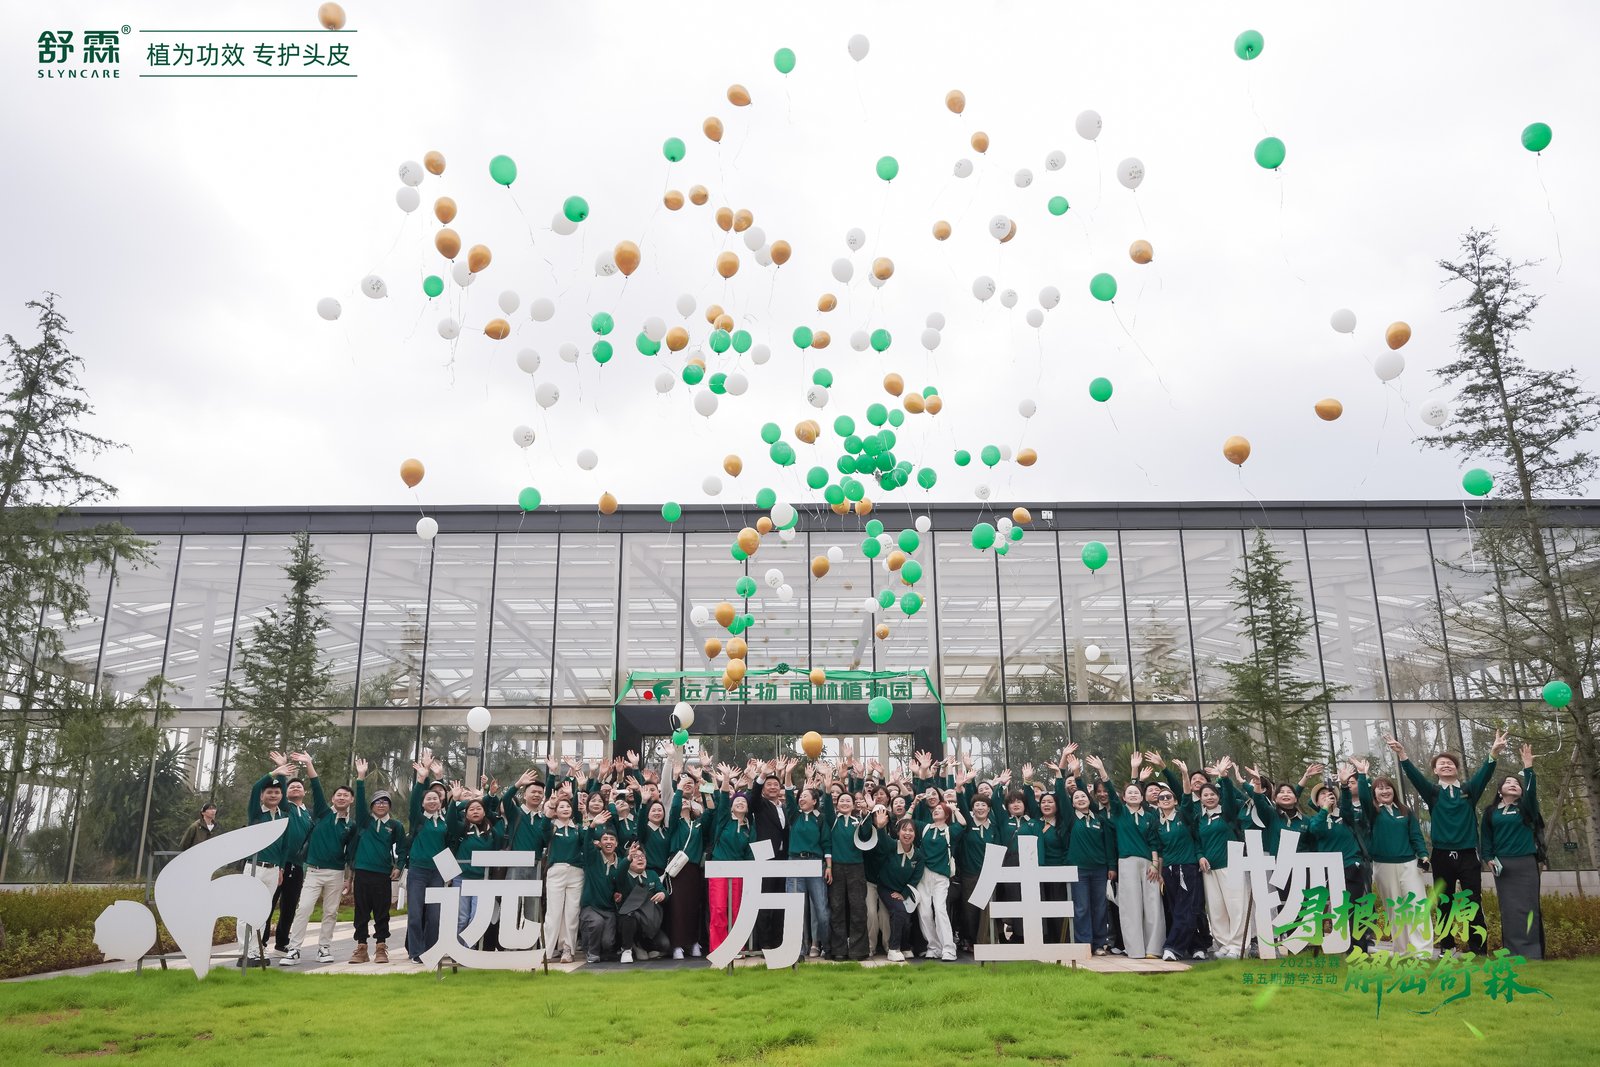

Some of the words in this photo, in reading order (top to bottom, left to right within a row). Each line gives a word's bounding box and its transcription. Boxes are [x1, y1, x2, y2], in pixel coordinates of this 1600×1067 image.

[681, 683, 777, 701] 远方生物
[790, 682, 913, 701] 雨林植物园
[419, 828, 1351, 970] 远方生物
